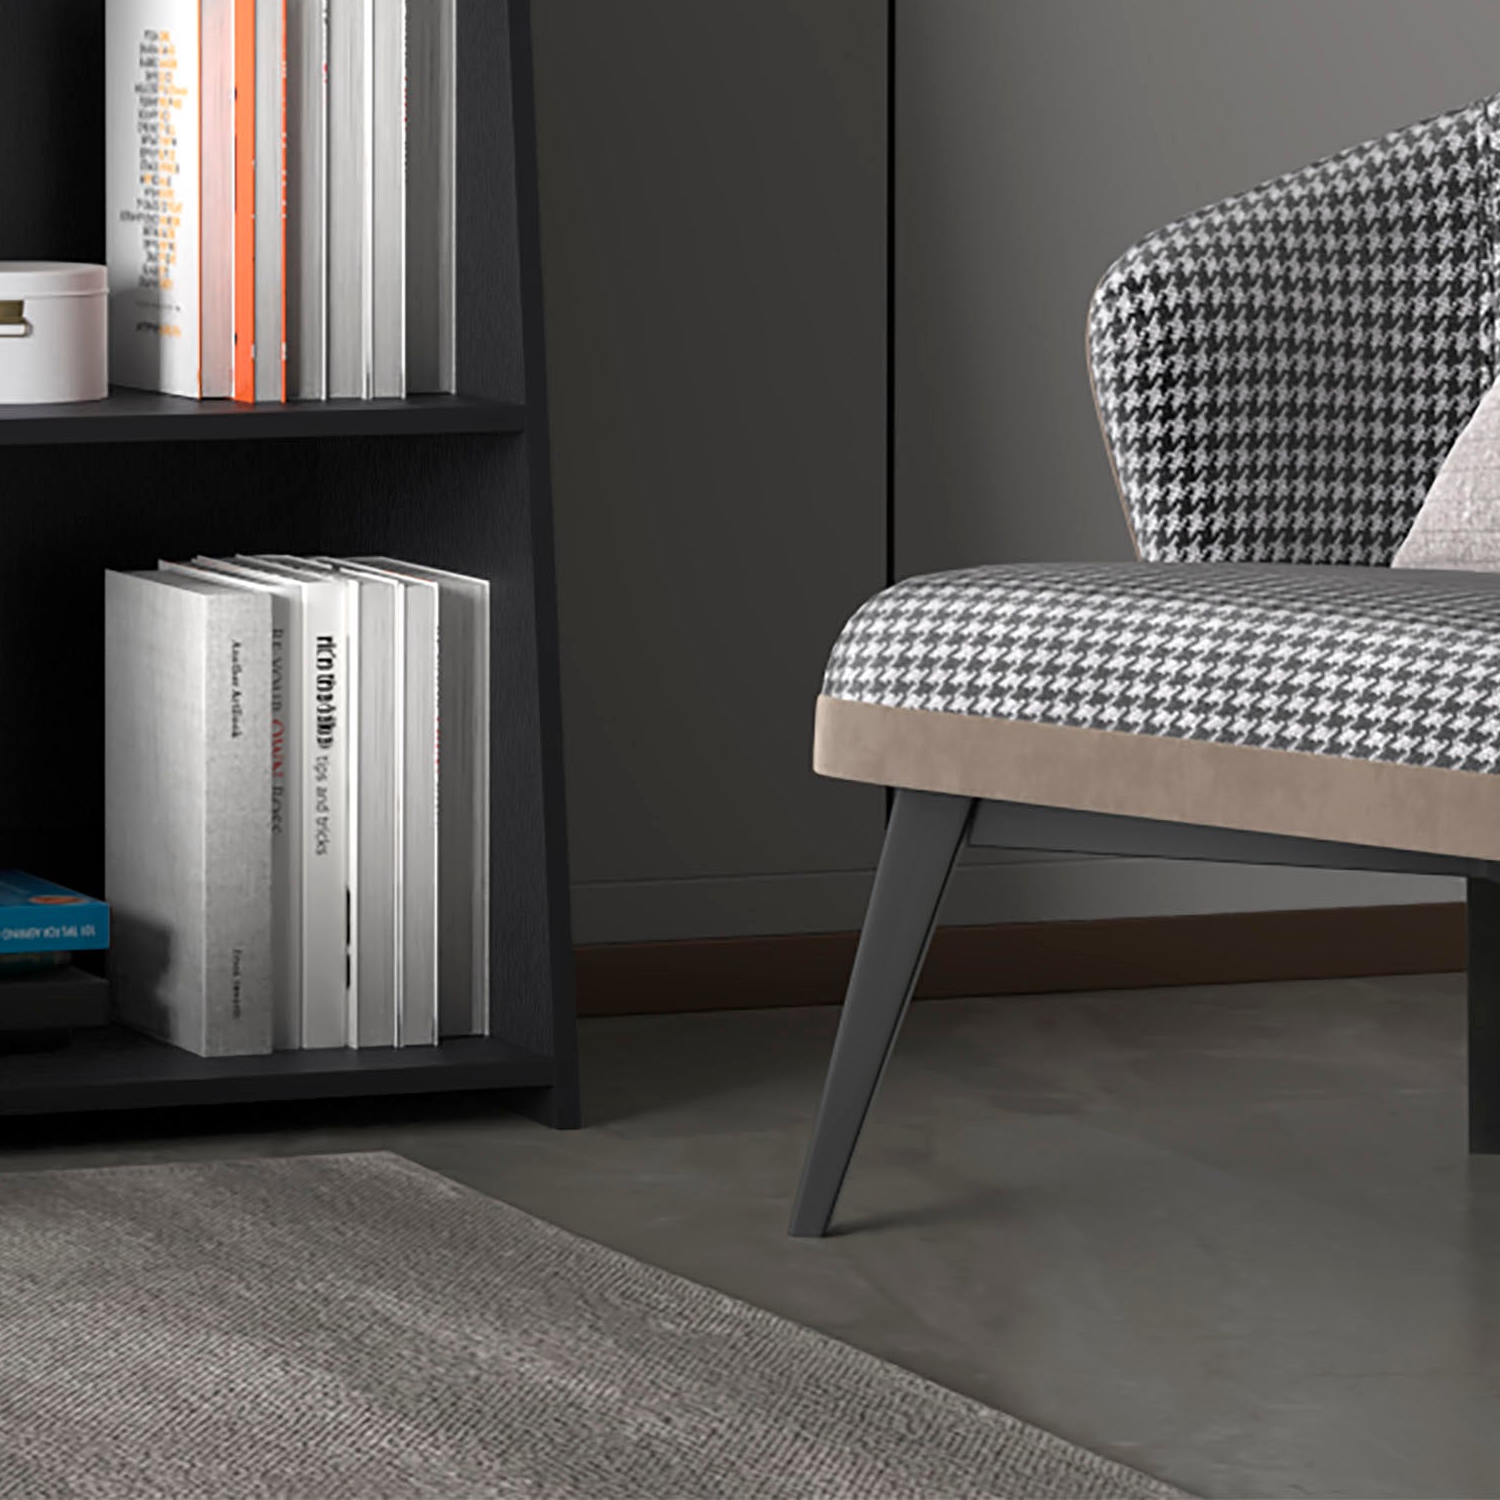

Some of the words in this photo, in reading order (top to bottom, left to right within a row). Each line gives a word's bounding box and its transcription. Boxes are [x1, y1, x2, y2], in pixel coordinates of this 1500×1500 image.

[313, 756, 329, 782] tips
[315, 785, 330, 813] and
[315, 816, 331, 856] tricks
